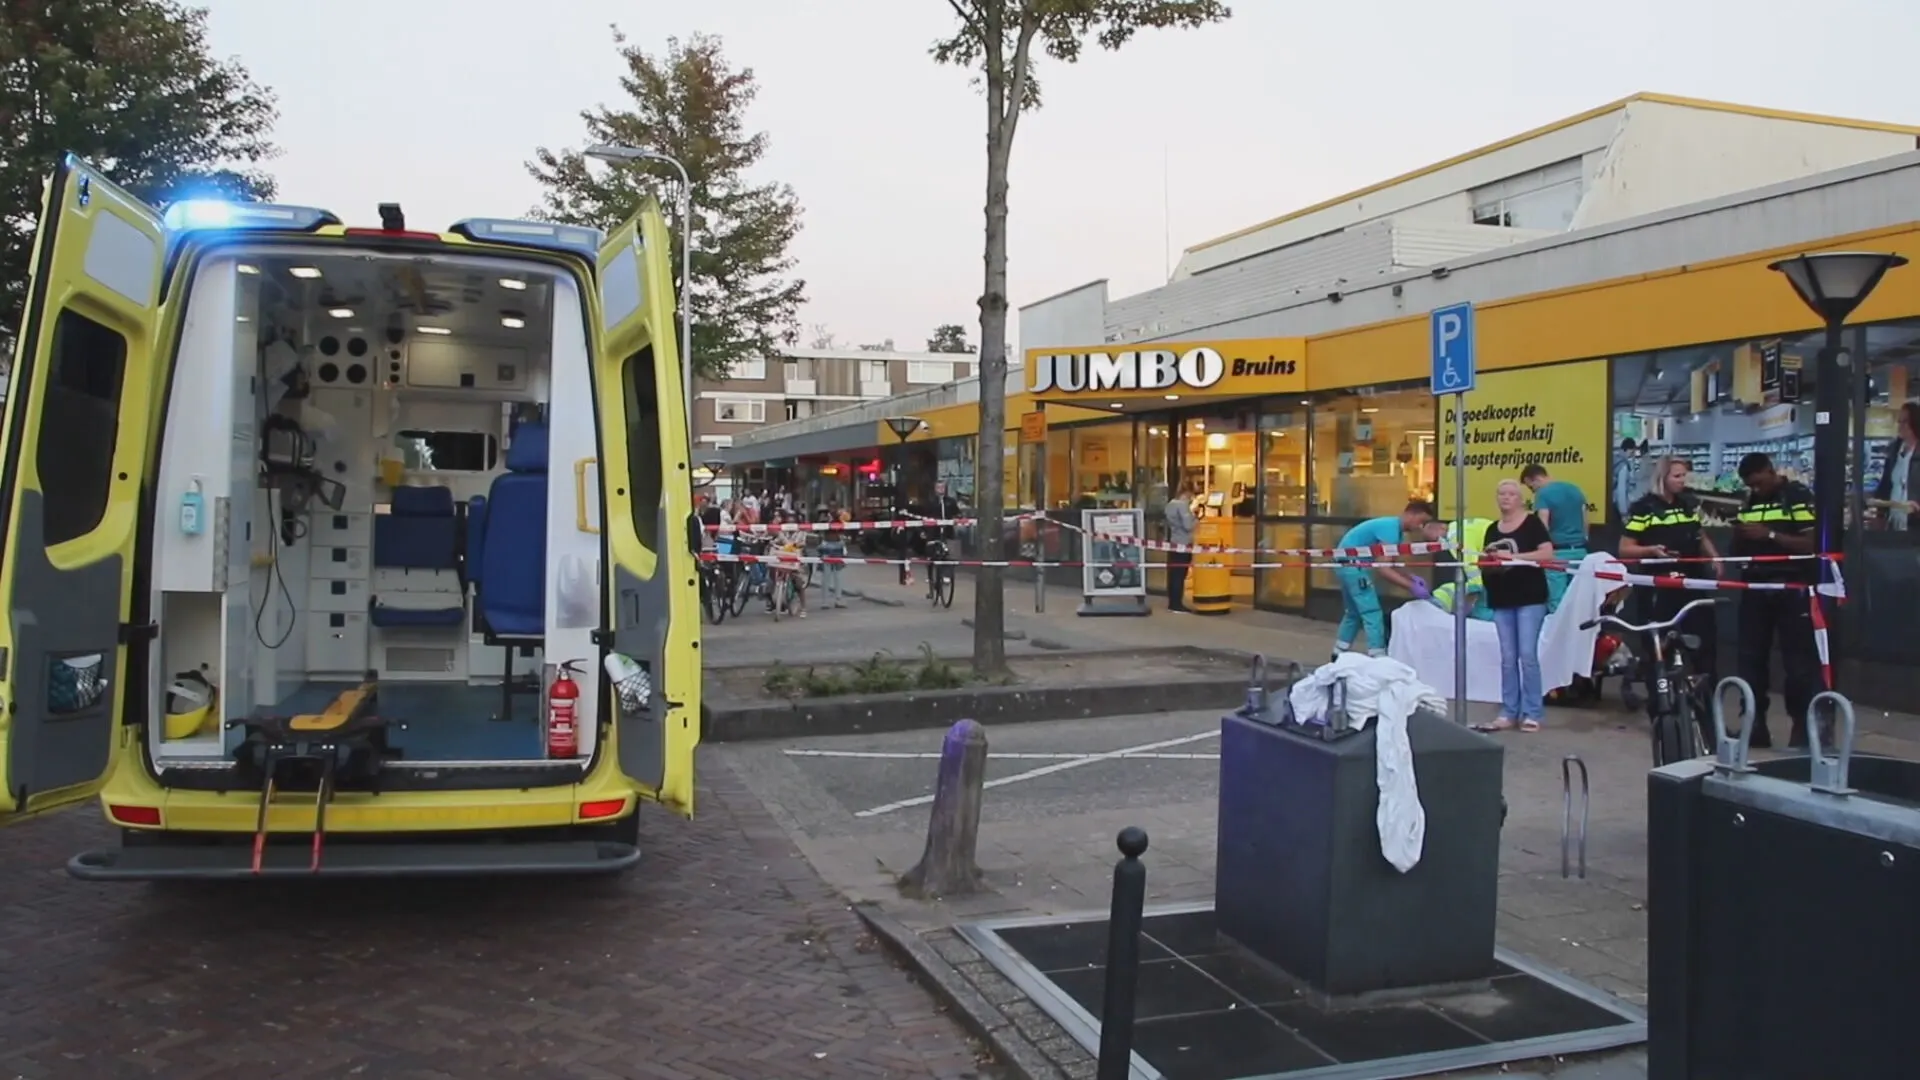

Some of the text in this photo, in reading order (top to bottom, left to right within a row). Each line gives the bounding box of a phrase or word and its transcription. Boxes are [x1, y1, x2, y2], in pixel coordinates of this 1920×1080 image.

[1439, 314, 1461, 357] P
[1029, 348, 1296, 392] JUMBO Bruins
[1462, 403, 1536, 427] goedkoopste
[1444, 430, 1455, 444] in
[1473, 428, 1505, 444] buurt
[1508, 423, 1554, 445] dankzij
[1461, 446, 1584, 470] aagsteprijsgarantie.
